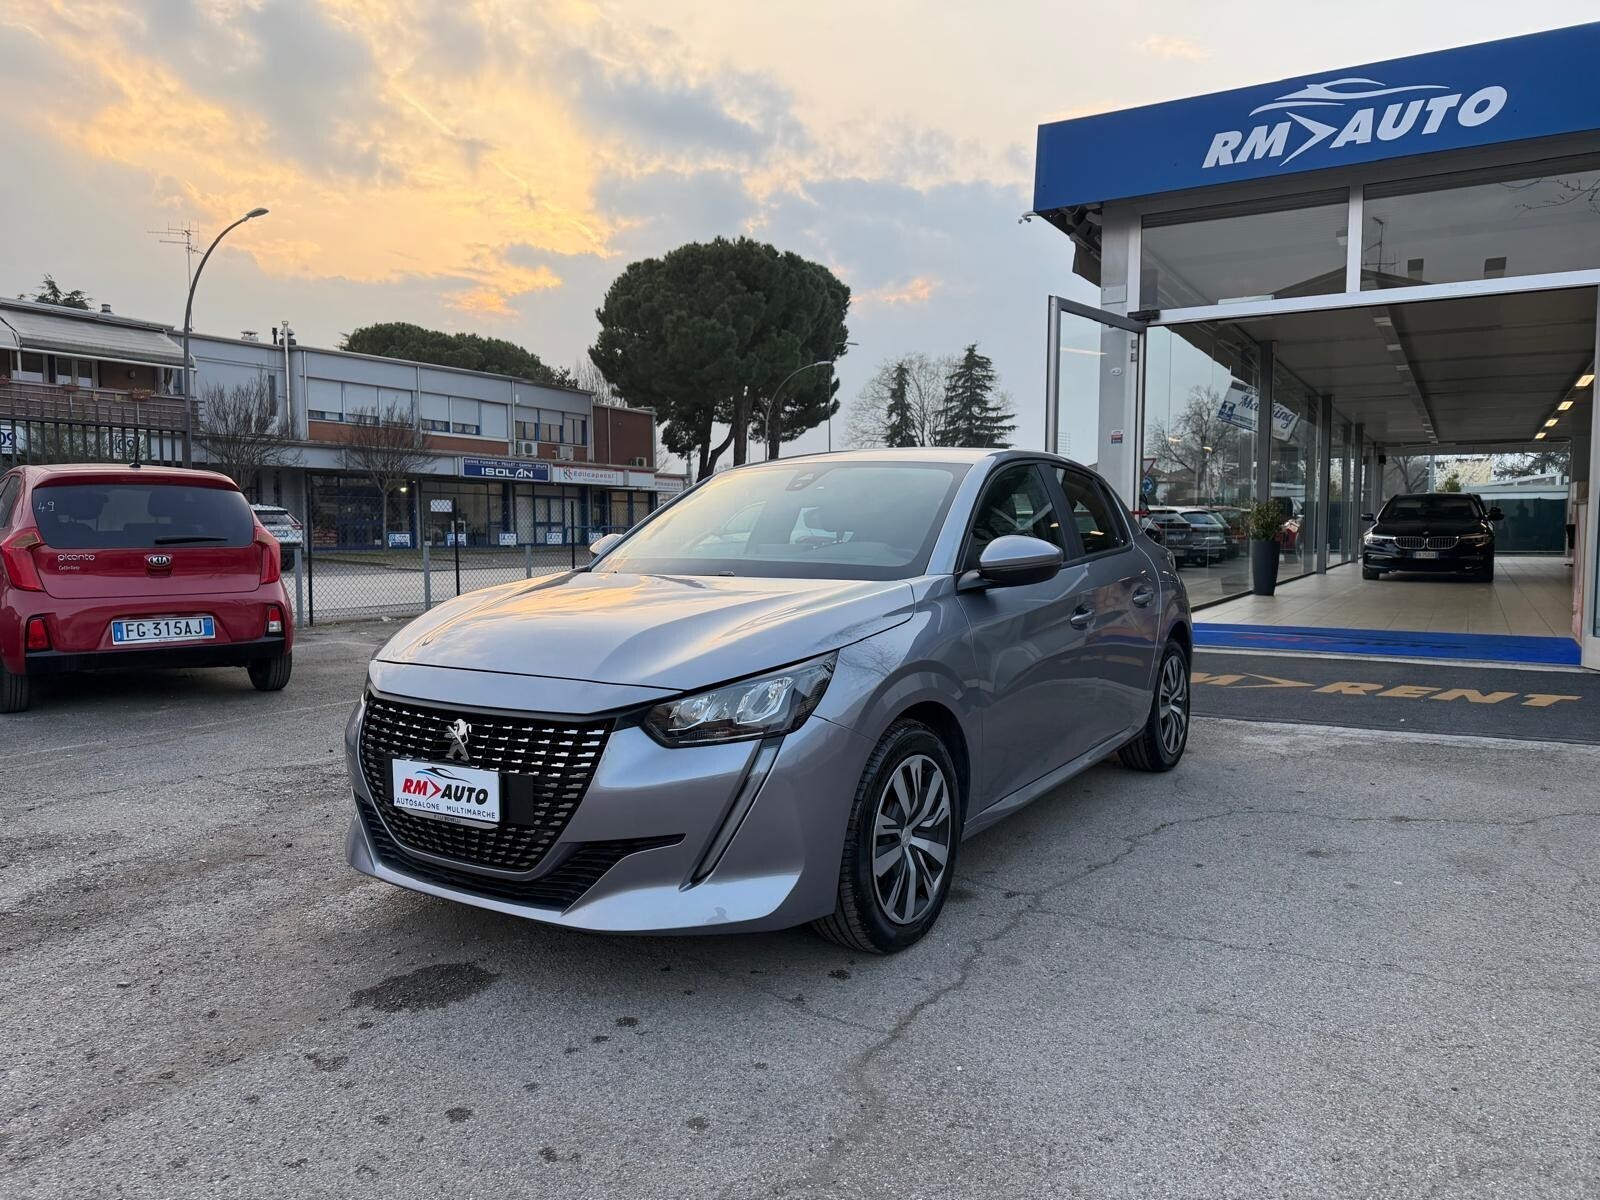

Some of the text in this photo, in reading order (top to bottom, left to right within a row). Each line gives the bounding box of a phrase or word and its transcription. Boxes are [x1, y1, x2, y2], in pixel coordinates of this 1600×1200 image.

[1202, 86, 1507, 168] RM AUTO
[481, 467, 534, 479] ISOLAN
[38, 501, 55, 512] 49
[57, 554, 96, 563] picanto
[152, 555, 168, 564] KIA
[153, 619, 203, 636] 315AJ
[1311, 681, 1582, 707] RENT
[402, 778, 488, 805] RM AUTO
[396, 797, 496, 819] AUTOSALONE MULTIMARCHE
